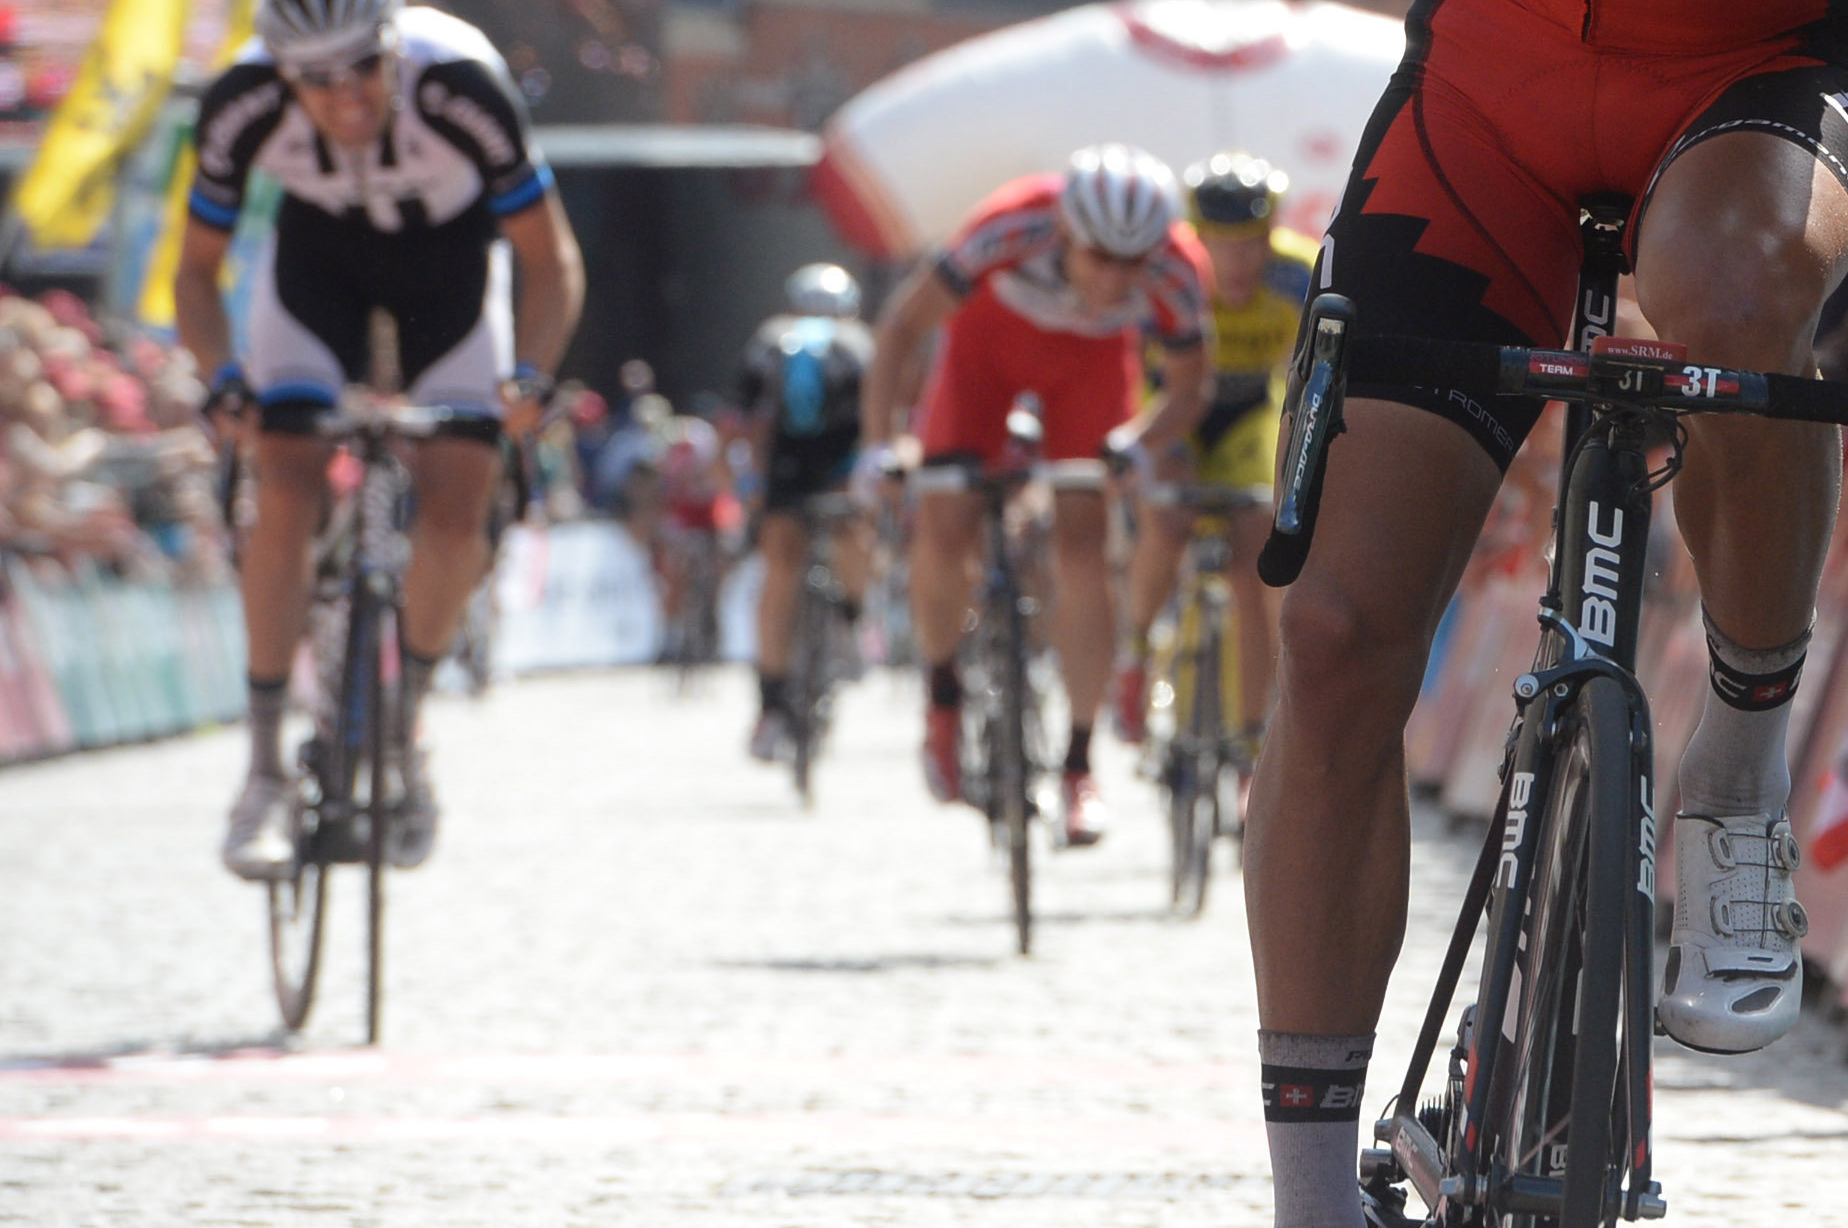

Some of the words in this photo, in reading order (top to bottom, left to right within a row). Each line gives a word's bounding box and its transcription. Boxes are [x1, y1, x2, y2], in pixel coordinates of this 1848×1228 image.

[1581, 289, 1609, 353] MC
[1607, 345, 1673, 360] www.SRM.de
[1540, 364, 1573, 376] TEAM
[1681, 366, 1722, 398] 3T
[1414, 384, 1515, 455] ROMER
[1578, 501, 1624, 647] BMC
[1496, 772, 1535, 889] BMC
[1637, 775, 1655, 905] BMC
